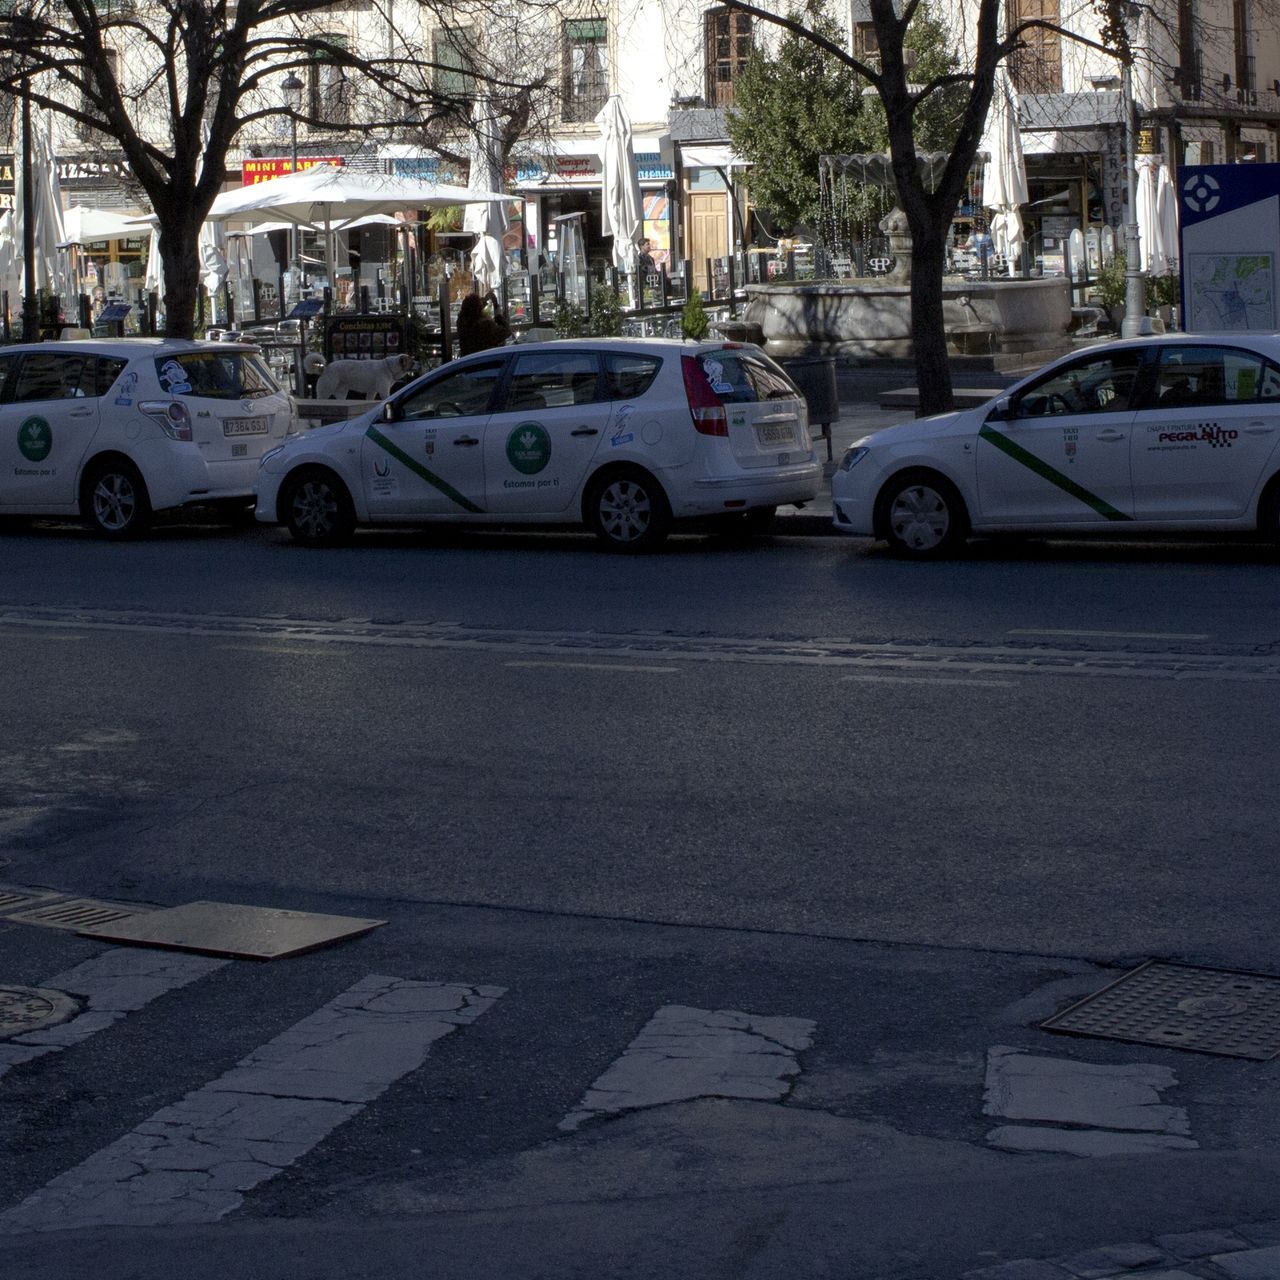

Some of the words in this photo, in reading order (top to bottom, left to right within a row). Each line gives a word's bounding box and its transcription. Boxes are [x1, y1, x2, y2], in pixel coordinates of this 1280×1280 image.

[245, 162, 276, 172] MINI
[503, 479, 535, 488] Estamos
[538, 480, 551, 489] por
